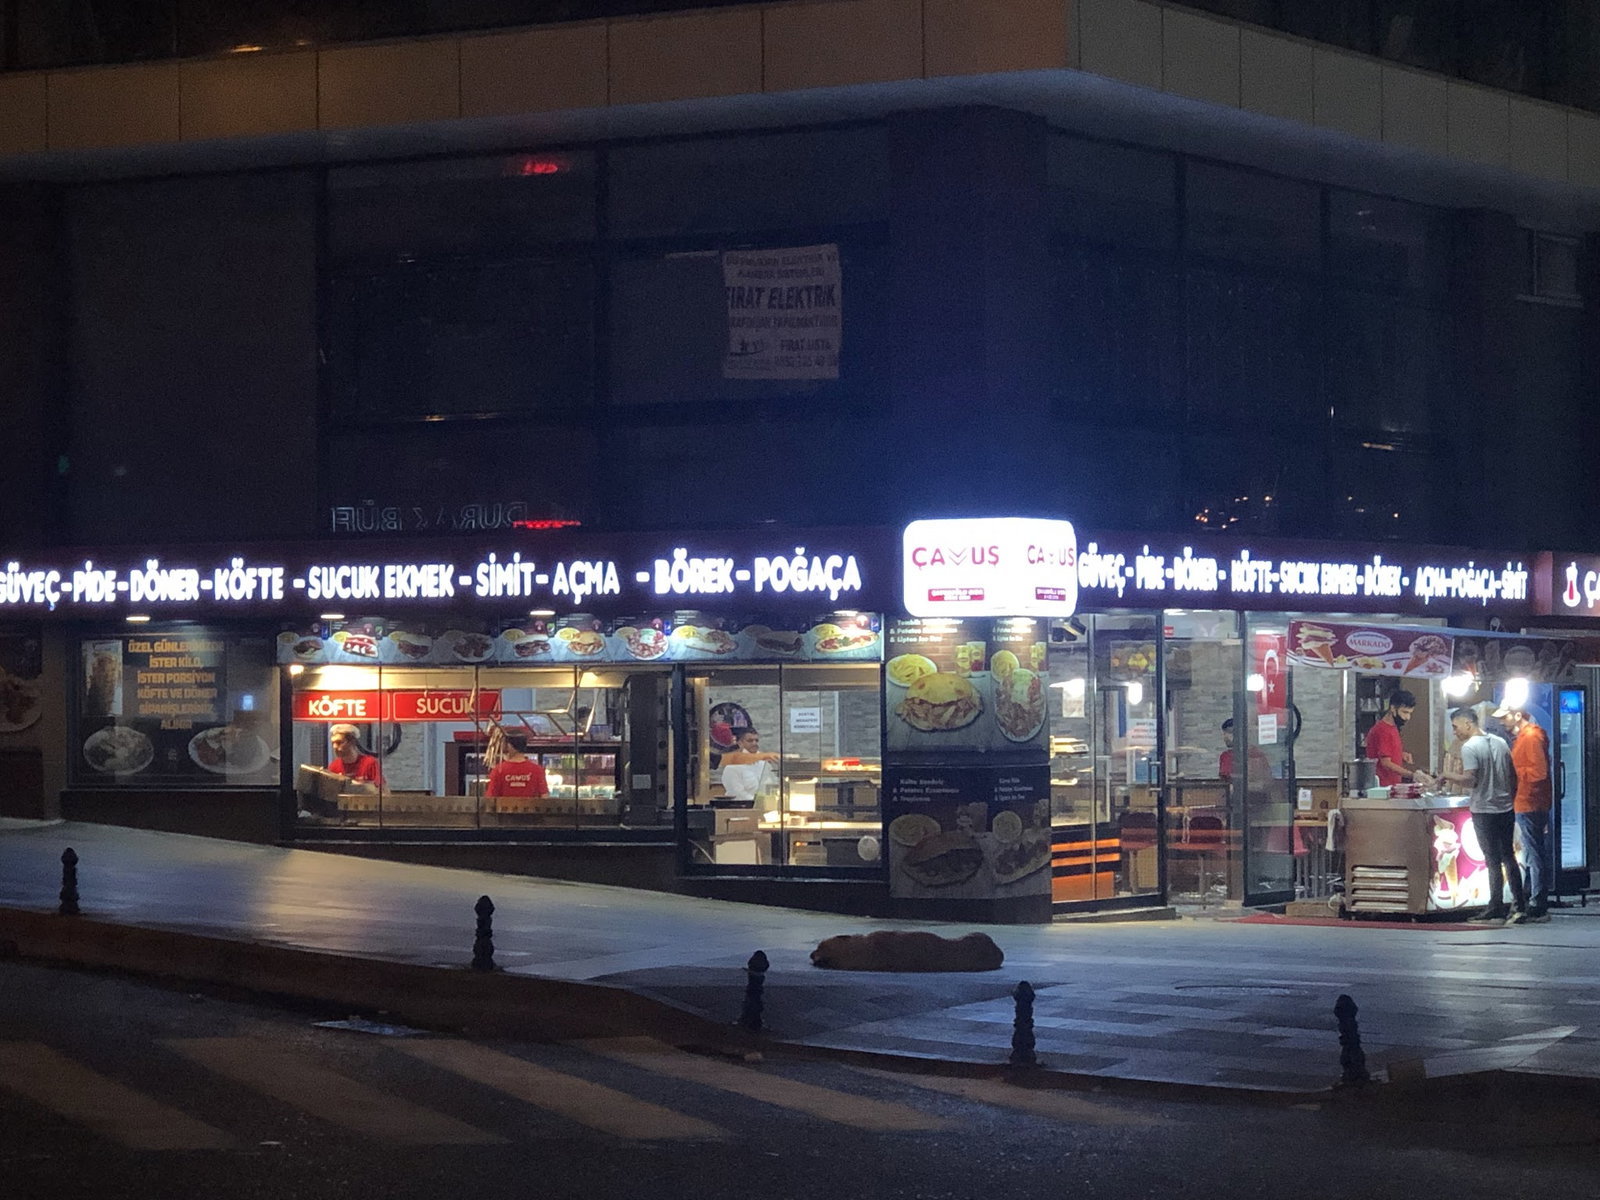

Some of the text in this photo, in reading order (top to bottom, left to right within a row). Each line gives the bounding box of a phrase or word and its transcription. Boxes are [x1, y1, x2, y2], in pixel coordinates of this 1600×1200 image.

[73, 560, 117, 602] PİDE
[130, 559, 200, 601] DÖNER
[214, 558, 284, 600] KÖFTE
[308, 566, 379, 599] SUCUK
[385, 565, 454, 598] EKMEK
[476, 552, 535, 597] SİMİT
[552, 561, 620, 605] AÇMA
[654, 548, 734, 594] BÖREK
[754, 547, 862, 601] POĞAÇA
[308, 696, 366, 716] KÖFTE
